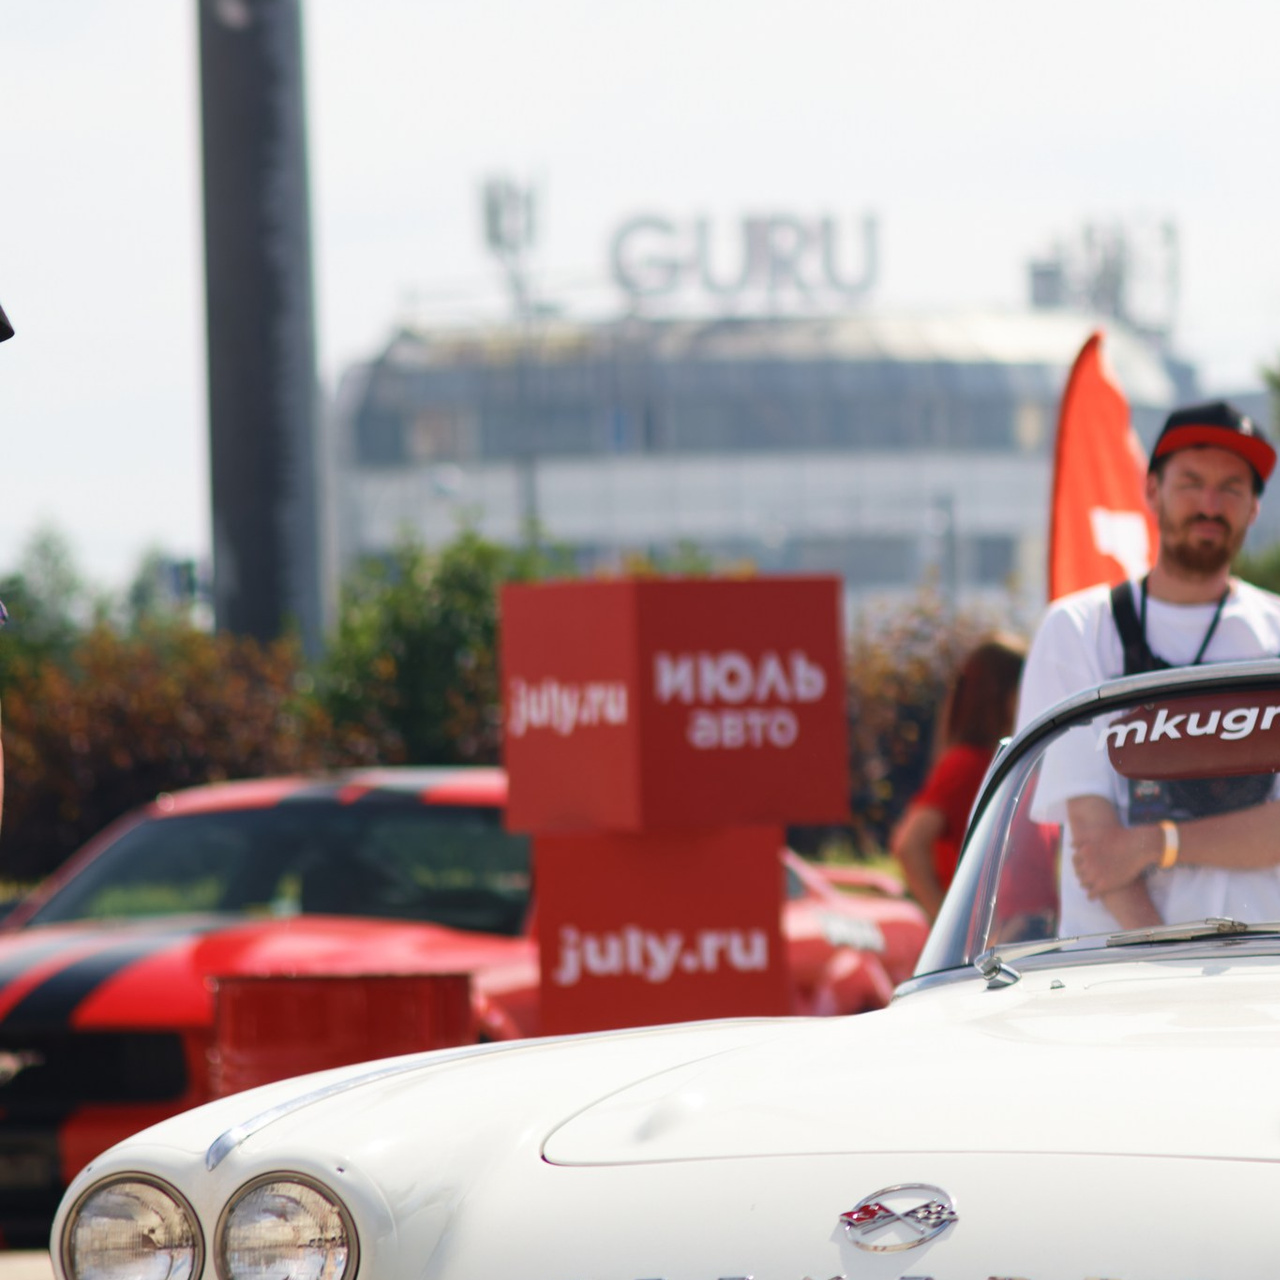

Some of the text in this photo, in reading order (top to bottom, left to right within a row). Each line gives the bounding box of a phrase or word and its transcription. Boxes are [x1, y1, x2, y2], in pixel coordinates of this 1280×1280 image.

[608, 212, 880, 296] GURU
[653, 651, 827, 705] ИЮЛЬ
[508, 682, 628, 737] july.ru
[552, 925, 769, 986] july.ru
